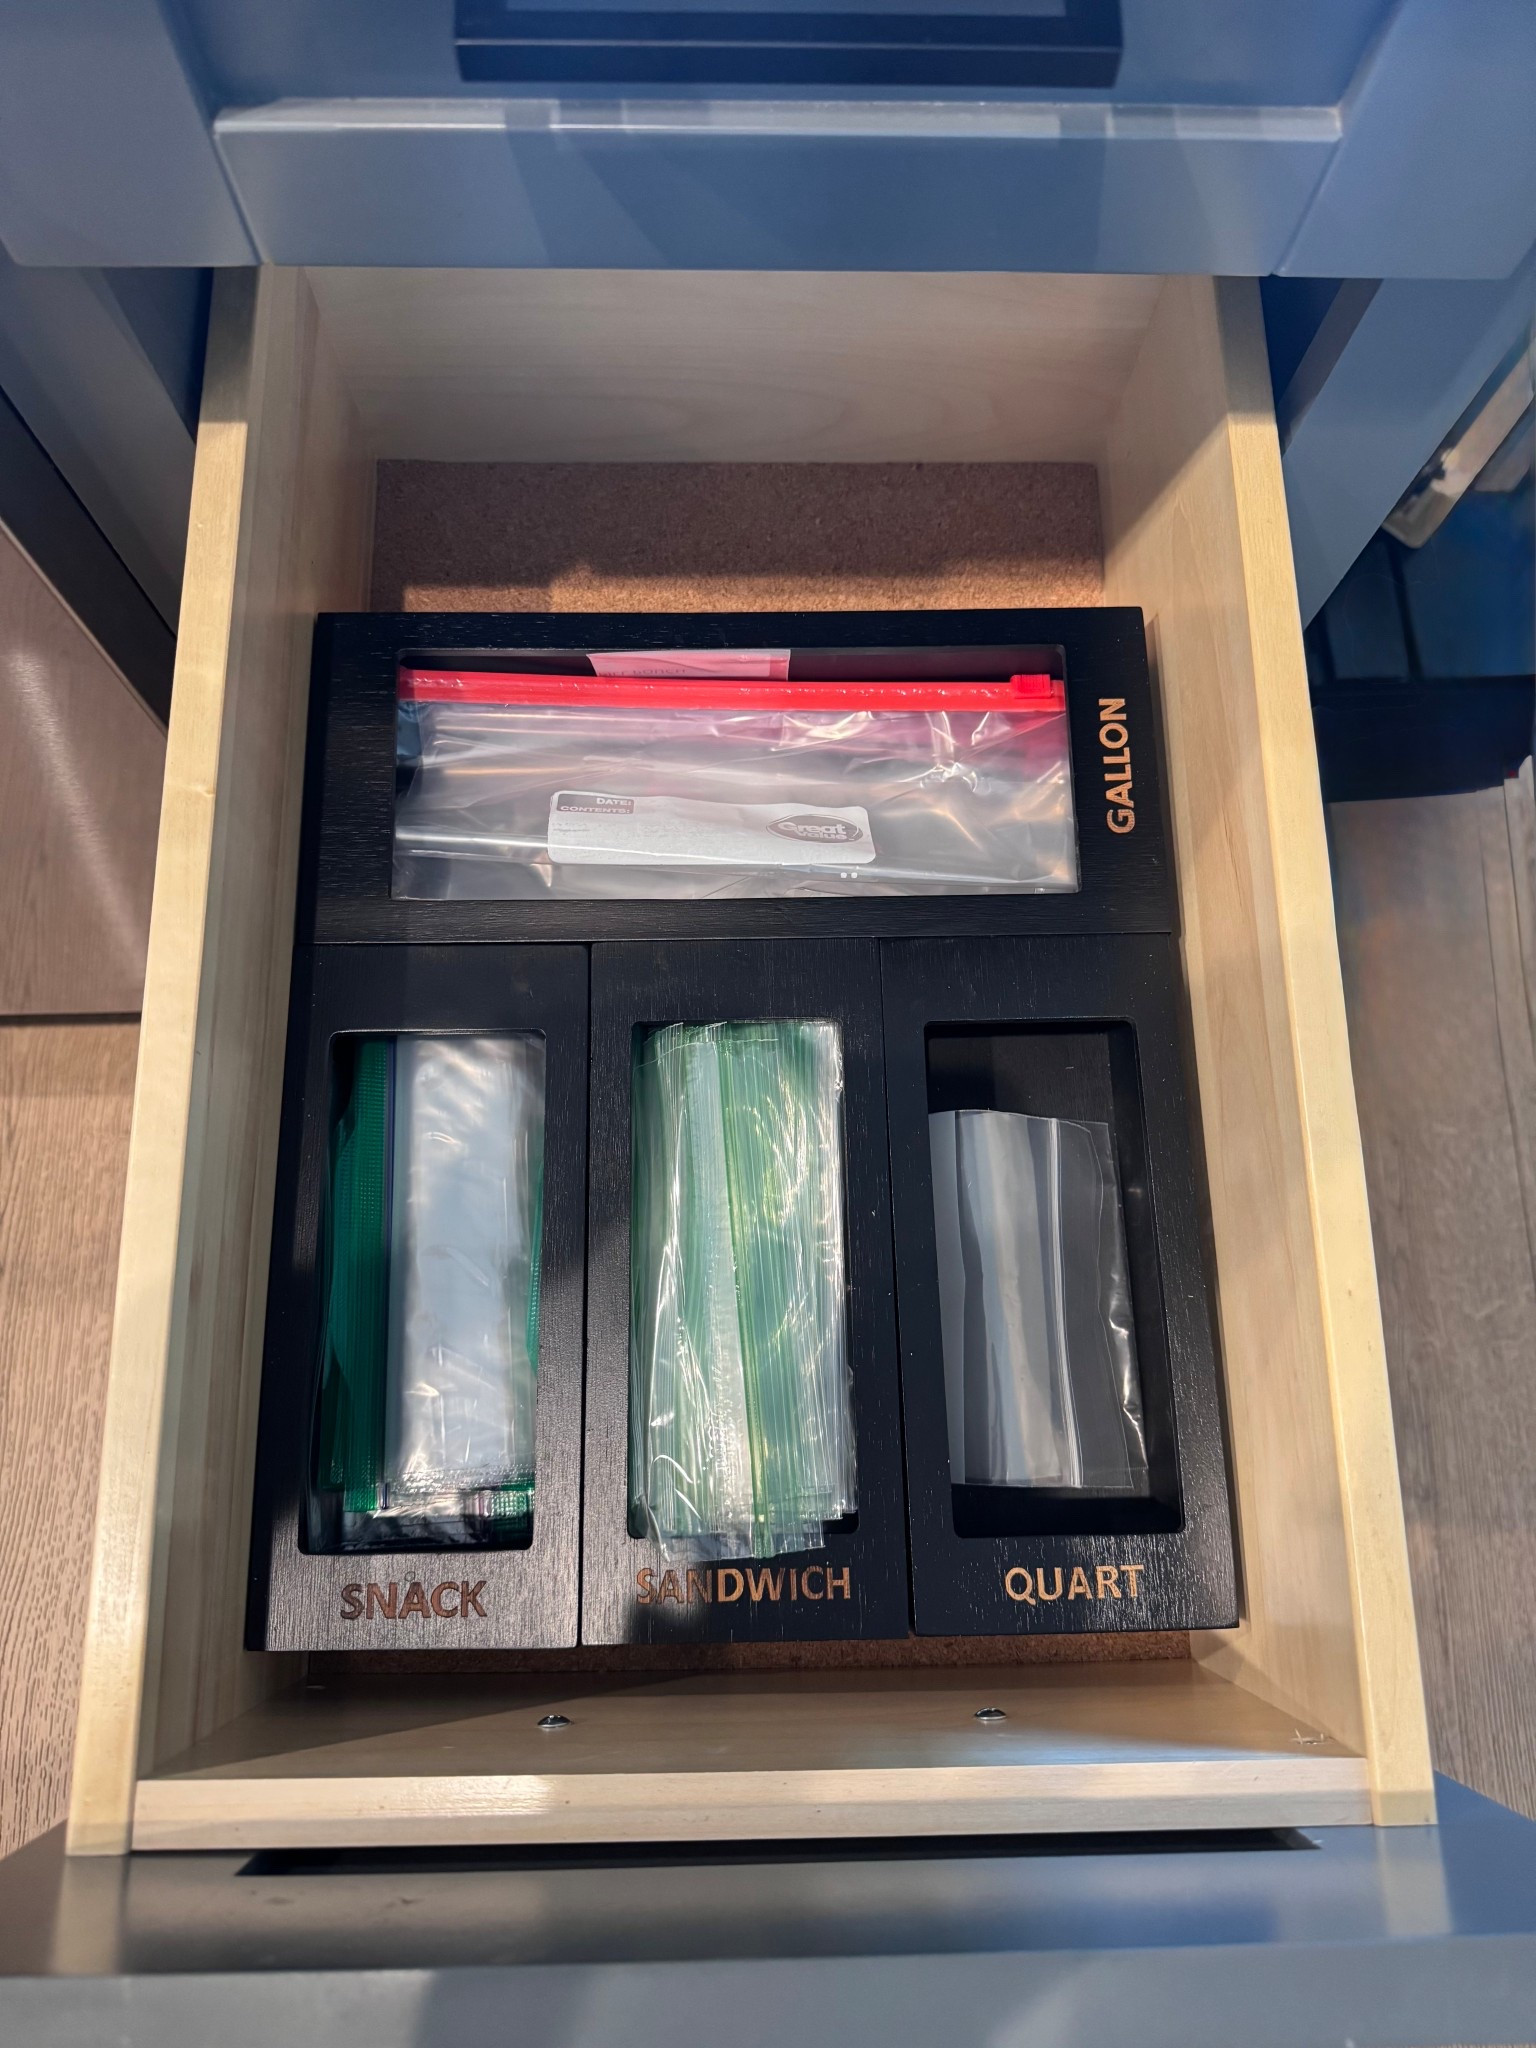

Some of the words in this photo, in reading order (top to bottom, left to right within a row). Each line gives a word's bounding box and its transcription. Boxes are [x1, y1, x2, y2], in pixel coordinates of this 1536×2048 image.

[1098, 697, 1136, 834] GALLON
[560, 805, 630, 814] CONTENTS:
[596, 797, 632, 806] DATE:
[777, 821, 847, 835] Great
[340, 1580, 488, 1621] SNACK
[636, 1565, 852, 1604] SANDWICH
[1004, 1564, 1145, 1606] QUART
